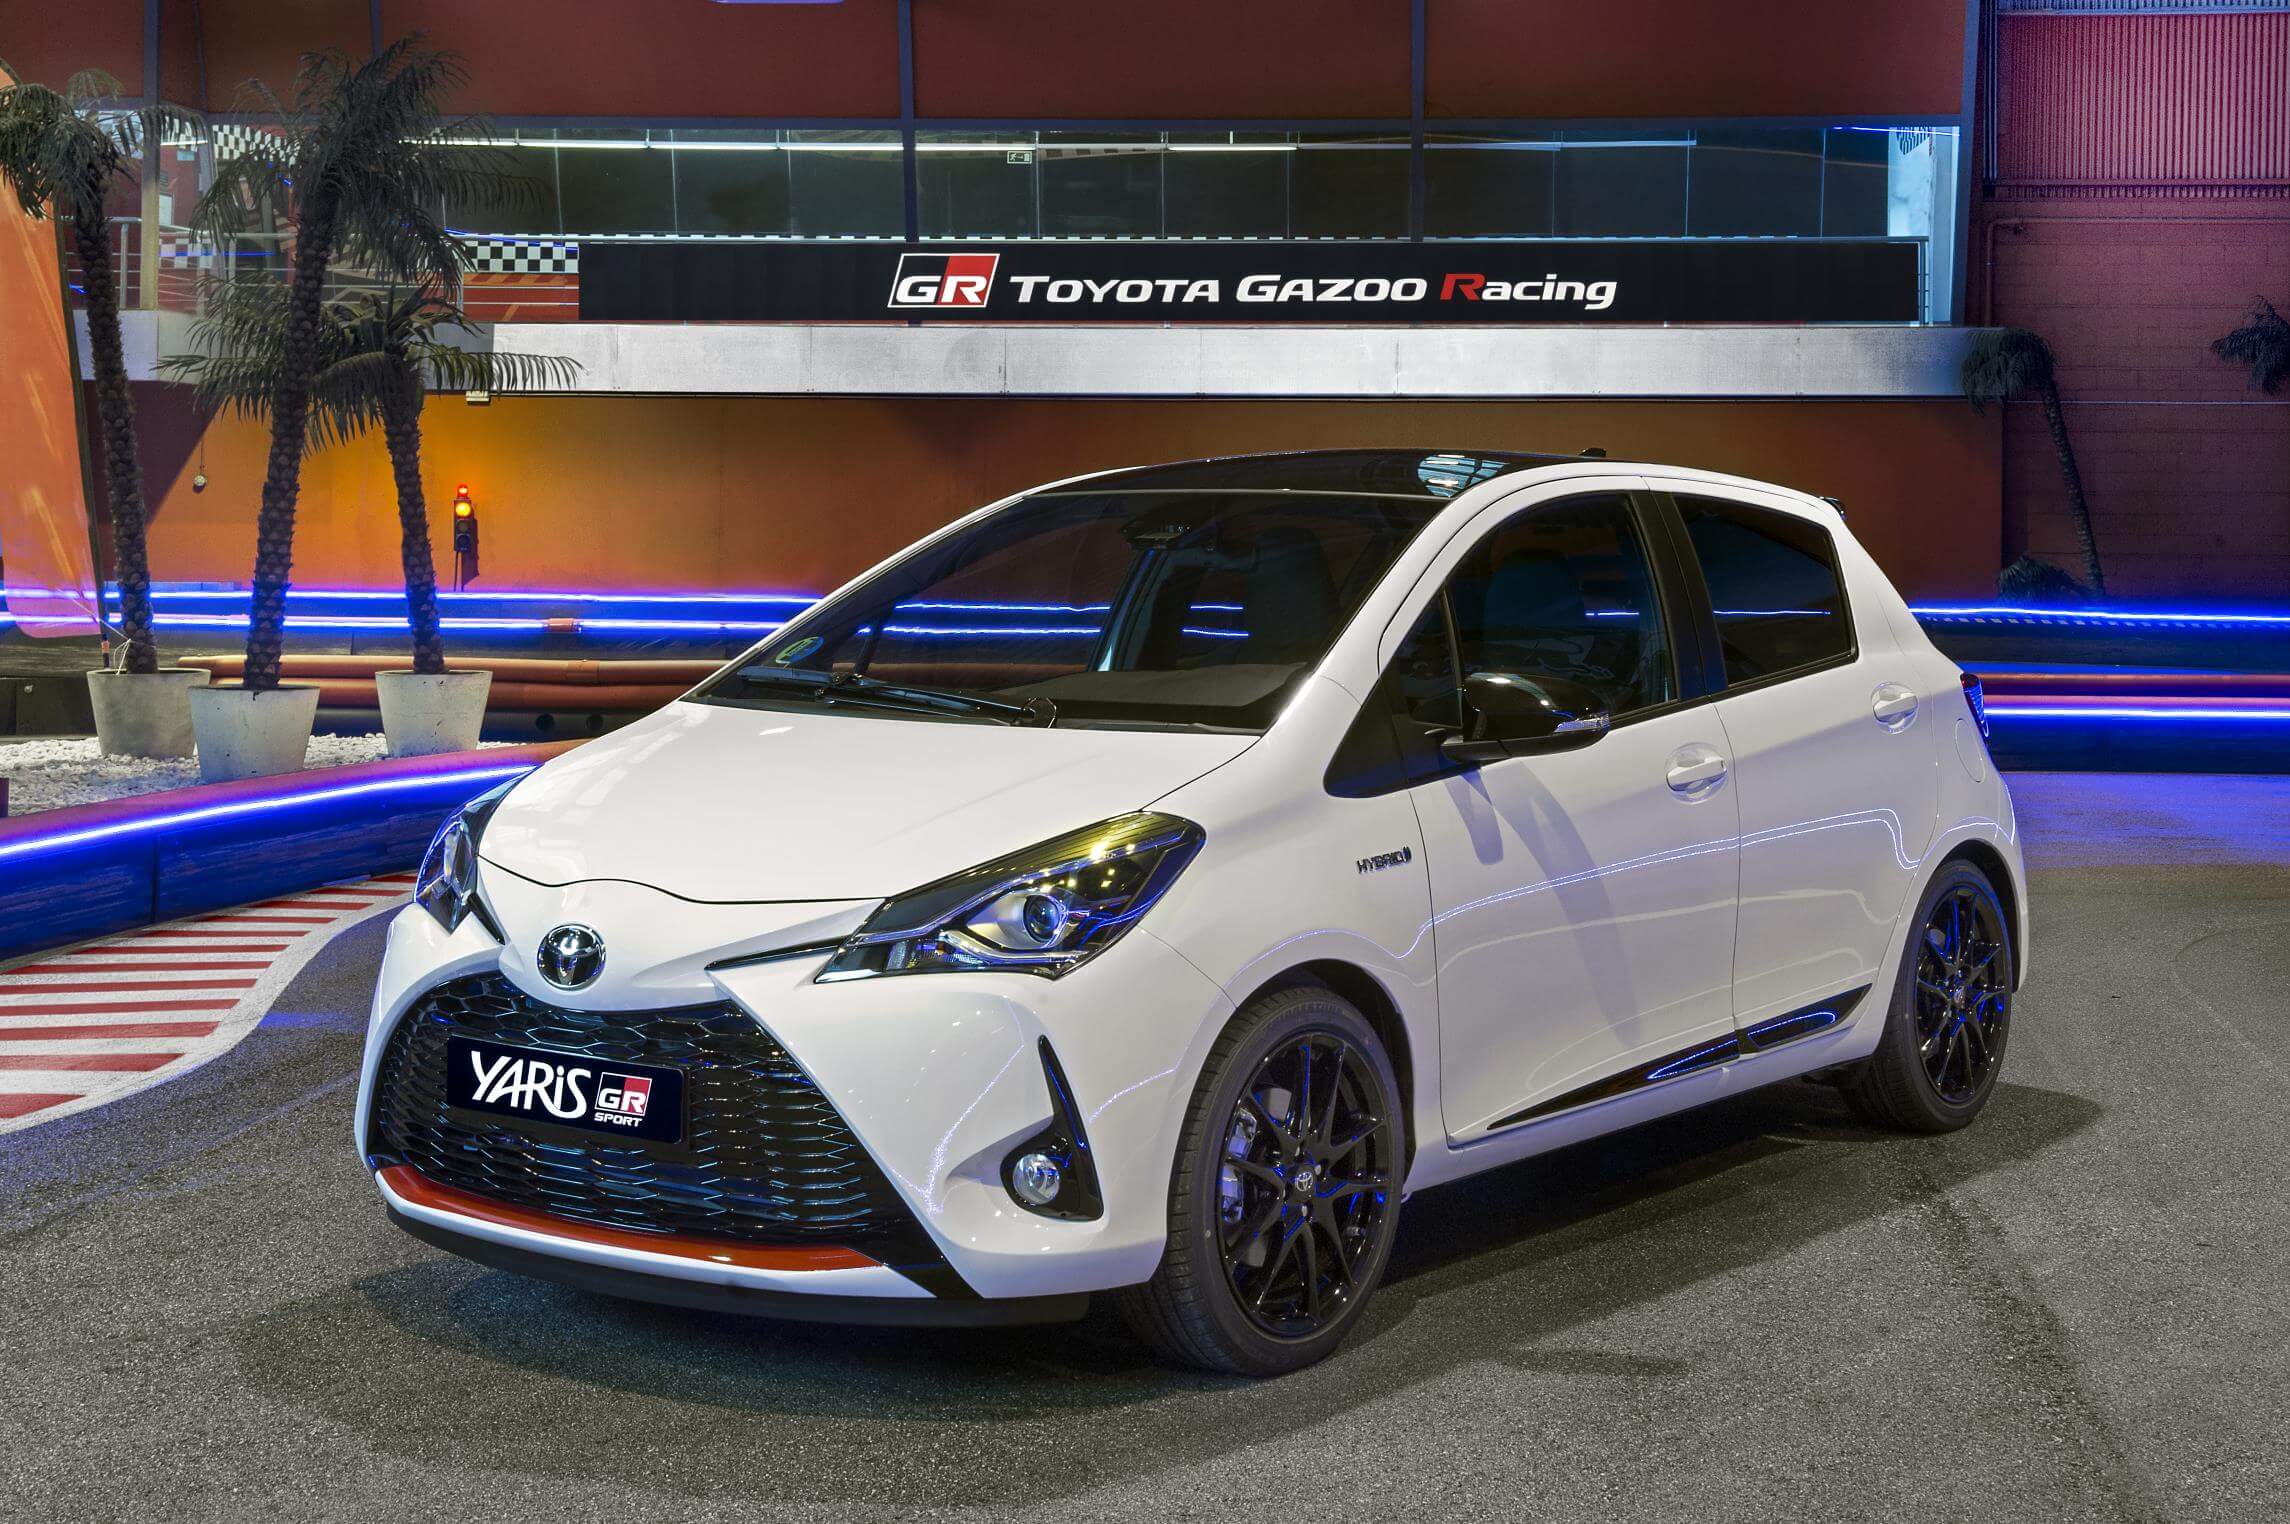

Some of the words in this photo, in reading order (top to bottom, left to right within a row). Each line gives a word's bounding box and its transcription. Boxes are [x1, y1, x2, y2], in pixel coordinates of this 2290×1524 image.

[896, 275, 988, 303] GR
[1440, 273, 1617, 310] Racing
[1357, 850, 1404, 874] HYBRID
[598, 1088, 647, 1114] GR
[594, 1112, 642, 1127] SPORT
